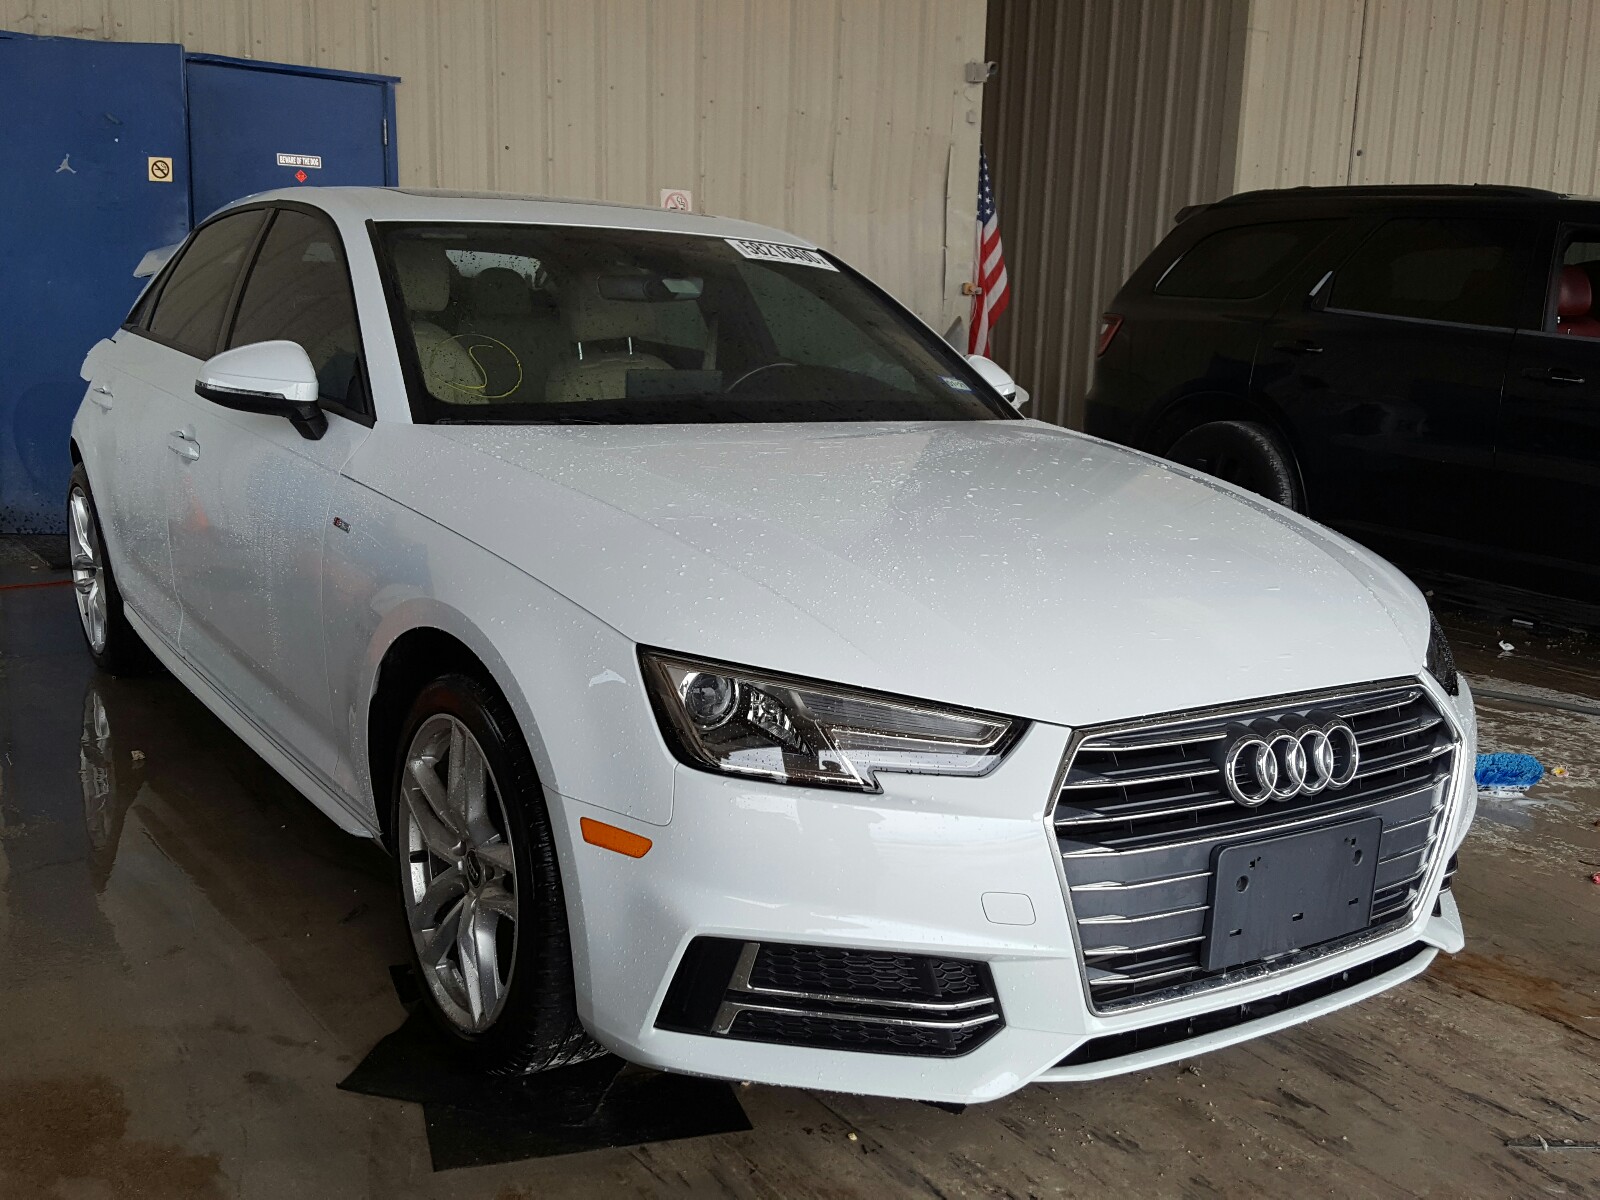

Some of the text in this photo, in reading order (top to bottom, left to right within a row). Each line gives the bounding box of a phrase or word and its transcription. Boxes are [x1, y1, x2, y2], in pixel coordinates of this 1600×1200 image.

[280, 156, 296, 164] BEWARE
[297, 156, 301, 164] OF
[302, 157, 310, 165] THE
[738, 240, 822, 264] 58216400
